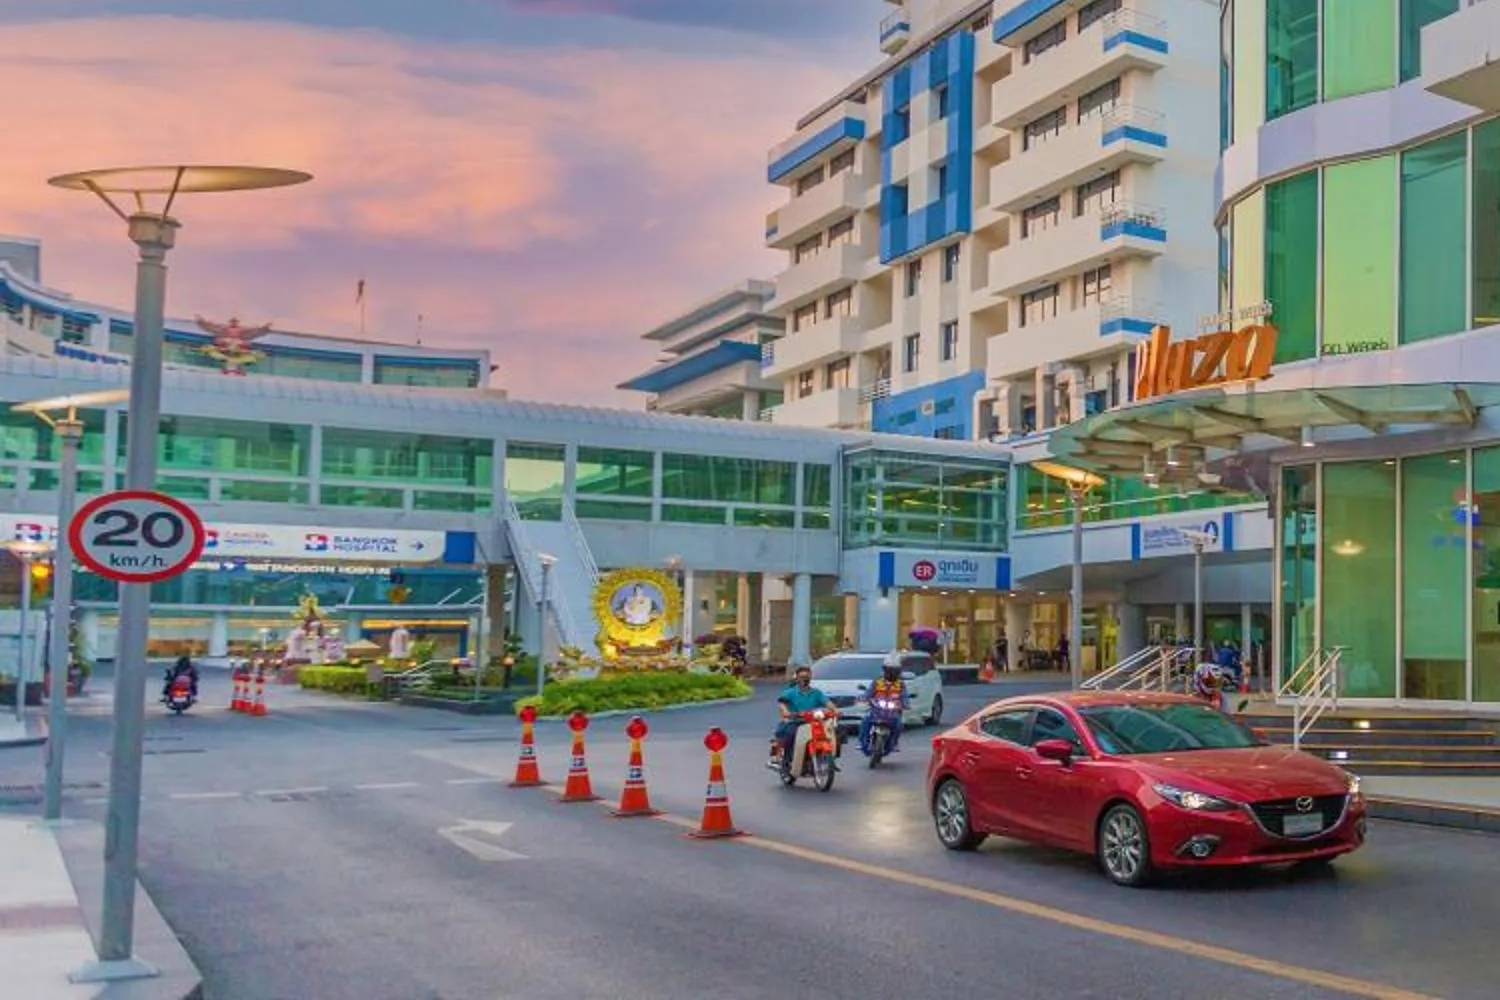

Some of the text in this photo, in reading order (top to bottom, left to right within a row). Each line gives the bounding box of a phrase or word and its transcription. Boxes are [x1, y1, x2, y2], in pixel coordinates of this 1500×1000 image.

[93, 509, 184, 548] 20
[334, 536, 397, 544] BANGKOK
[334, 544, 398, 552] HOSPITAL
[916, 564, 932, 577] ER
